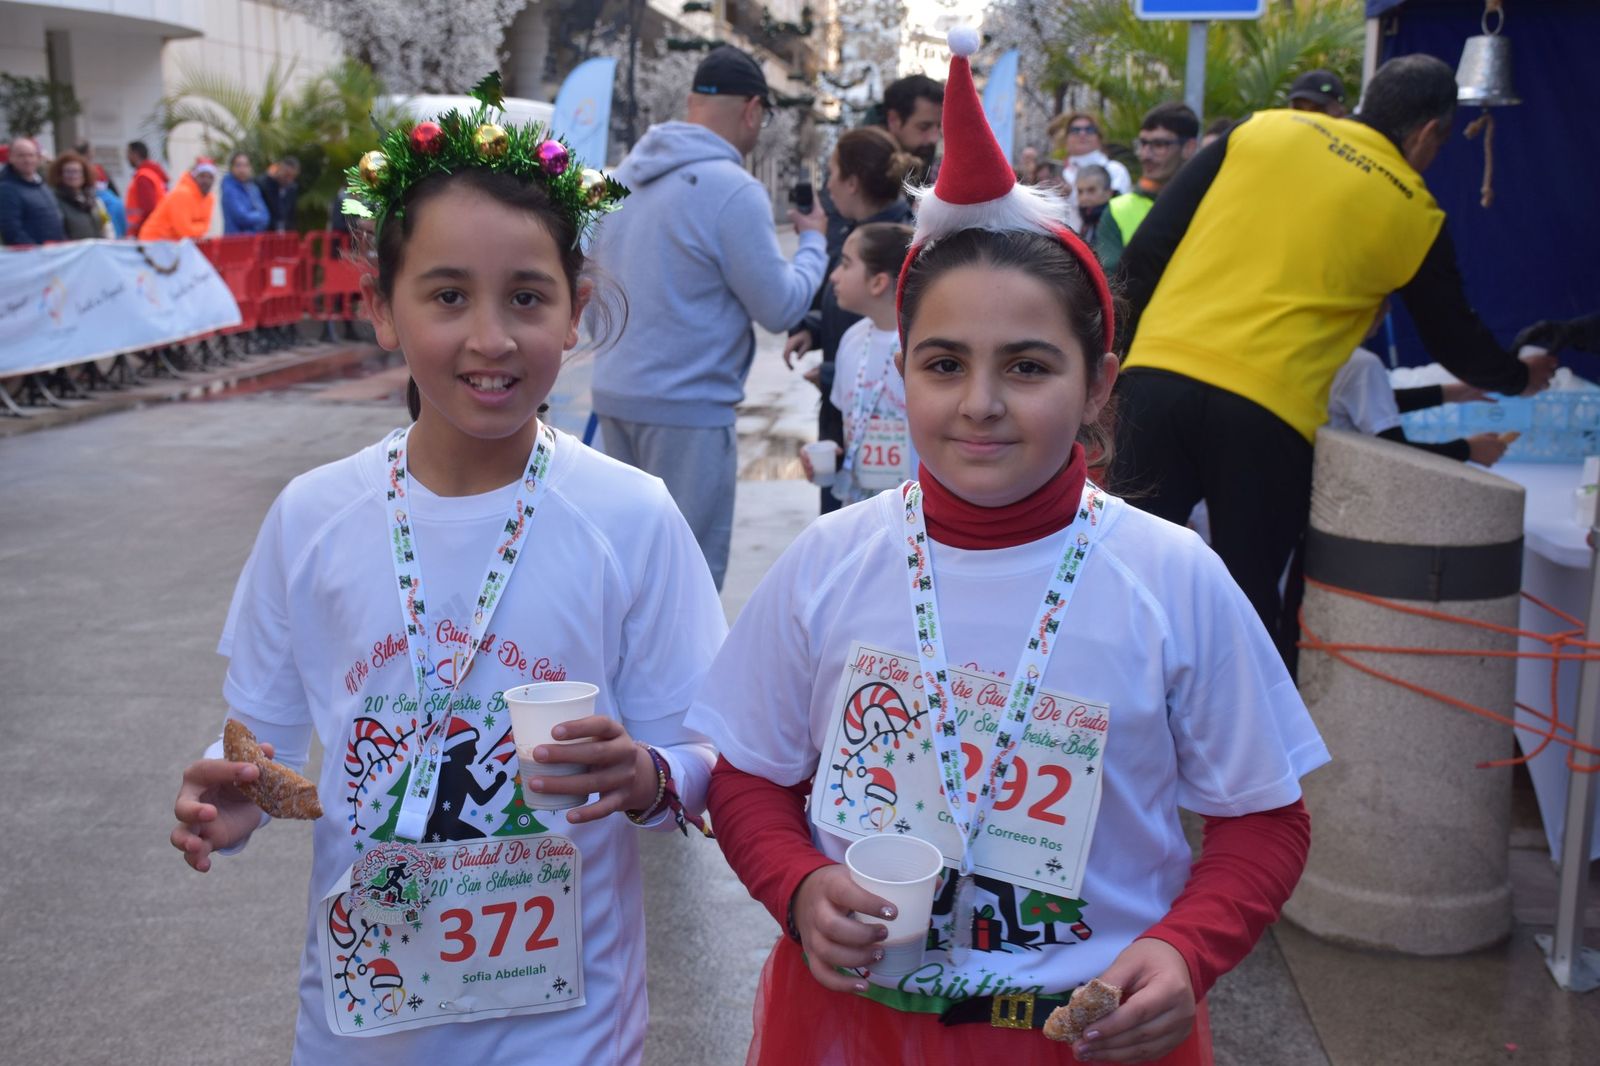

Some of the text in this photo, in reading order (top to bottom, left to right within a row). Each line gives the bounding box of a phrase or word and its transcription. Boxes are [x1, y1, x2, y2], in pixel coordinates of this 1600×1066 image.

[863, 444, 901, 467] 216
[498, 641, 527, 671] De
[392, 692, 418, 714] San
[424, 692, 482, 713] Silestre
[879, 658, 909, 682] San
[1032, 696, 1062, 721] De
[1066, 705, 1108, 732] Ceuta
[1061, 733, 1100, 762] Baby
[987, 824, 1063, 852] Correeo Ros
[453, 842, 503, 870] Ciudad
[505, 841, 531, 864] De
[536, 838, 575, 860] Ceuta
[457, 874, 481, 896] San
[486, 869, 533, 892] Silvestre
[537, 862, 571, 883] Baby
[440, 895, 559, 962] 372
[462, 963, 547, 984] Sofia Abdellah
